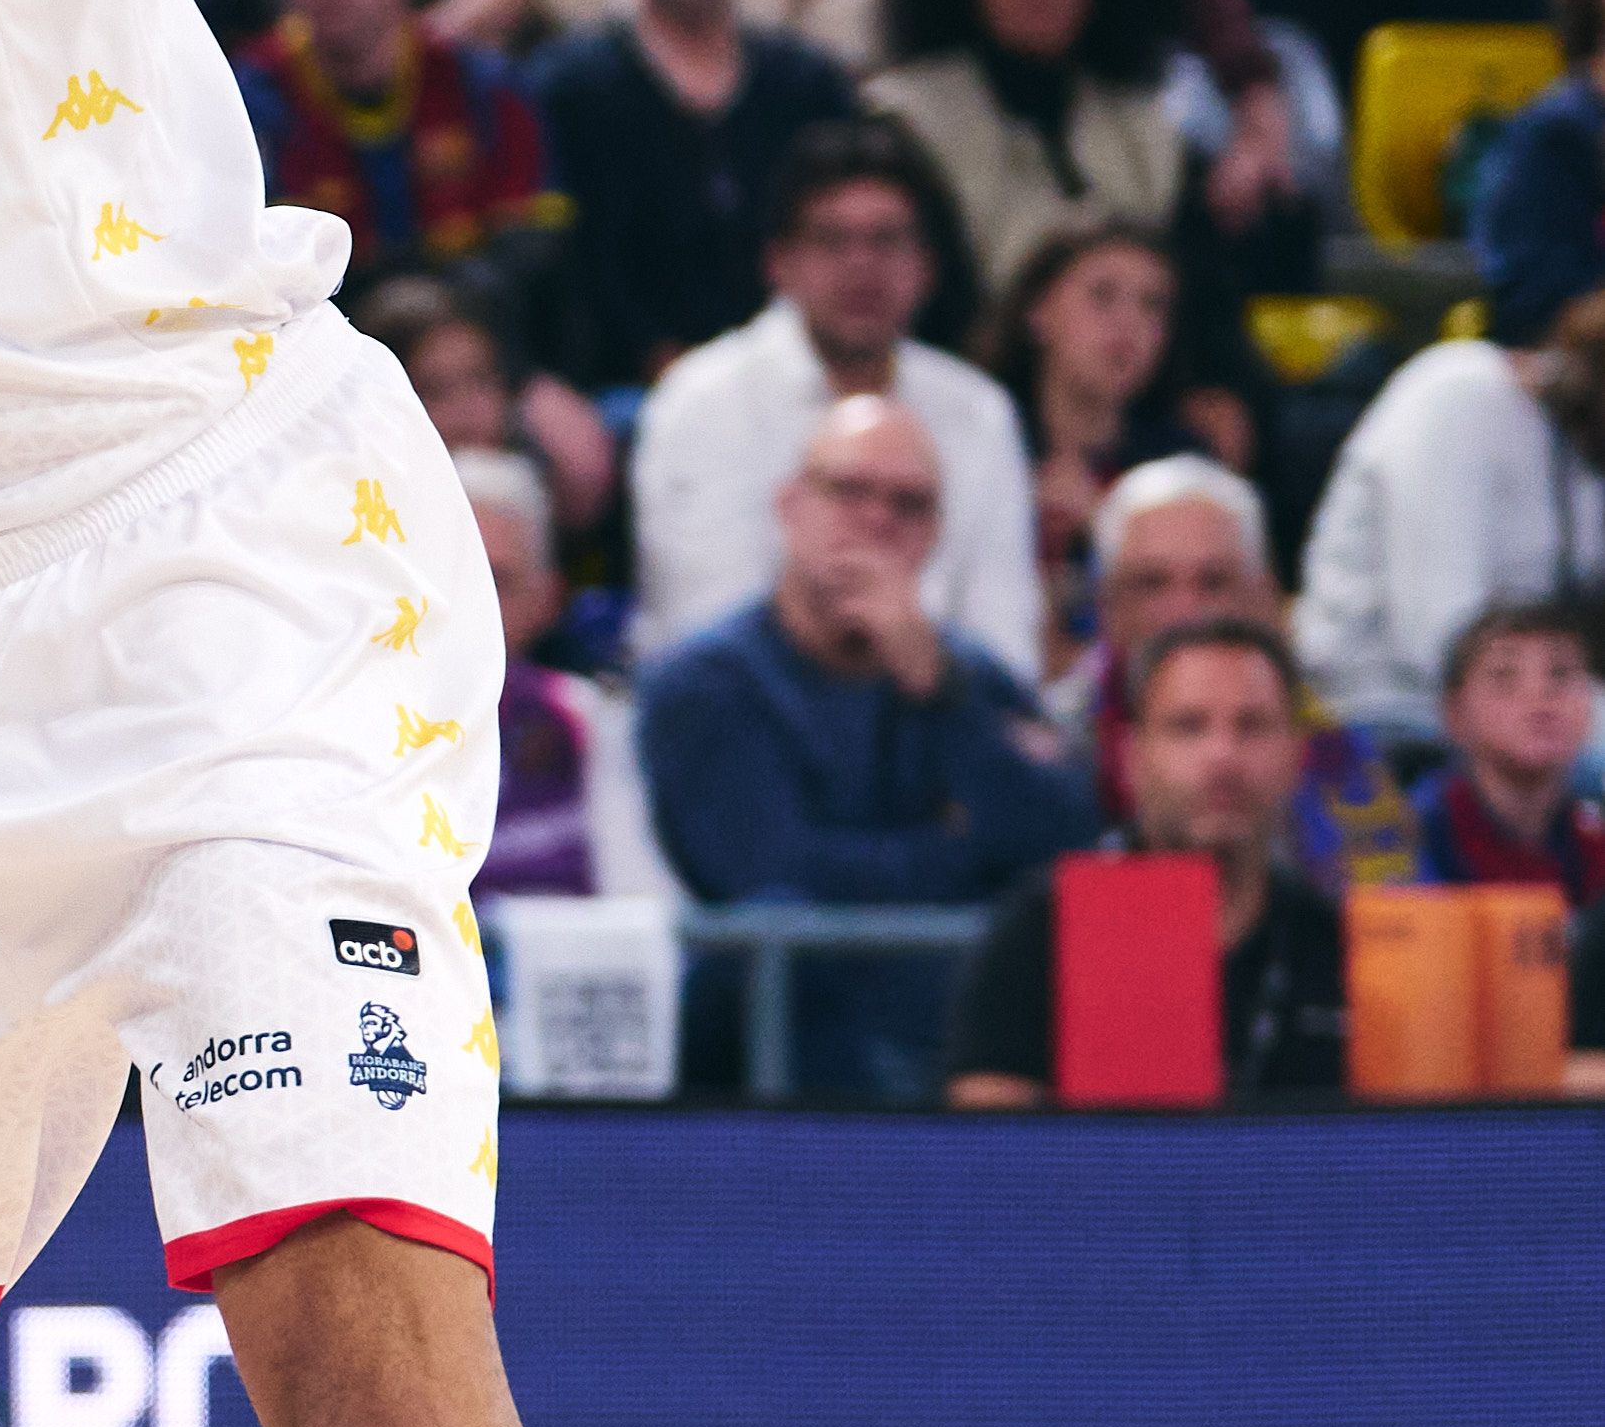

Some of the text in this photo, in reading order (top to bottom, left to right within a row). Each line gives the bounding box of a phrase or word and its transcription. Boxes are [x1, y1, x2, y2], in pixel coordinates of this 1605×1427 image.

[339, 939, 403, 969] acb
[182, 1030, 292, 1083] andorra
[351, 1054, 426, 1072] MORABANC
[174, 1066, 303, 1112] telecom
[351, 1067, 426, 1093] ANDORRA
